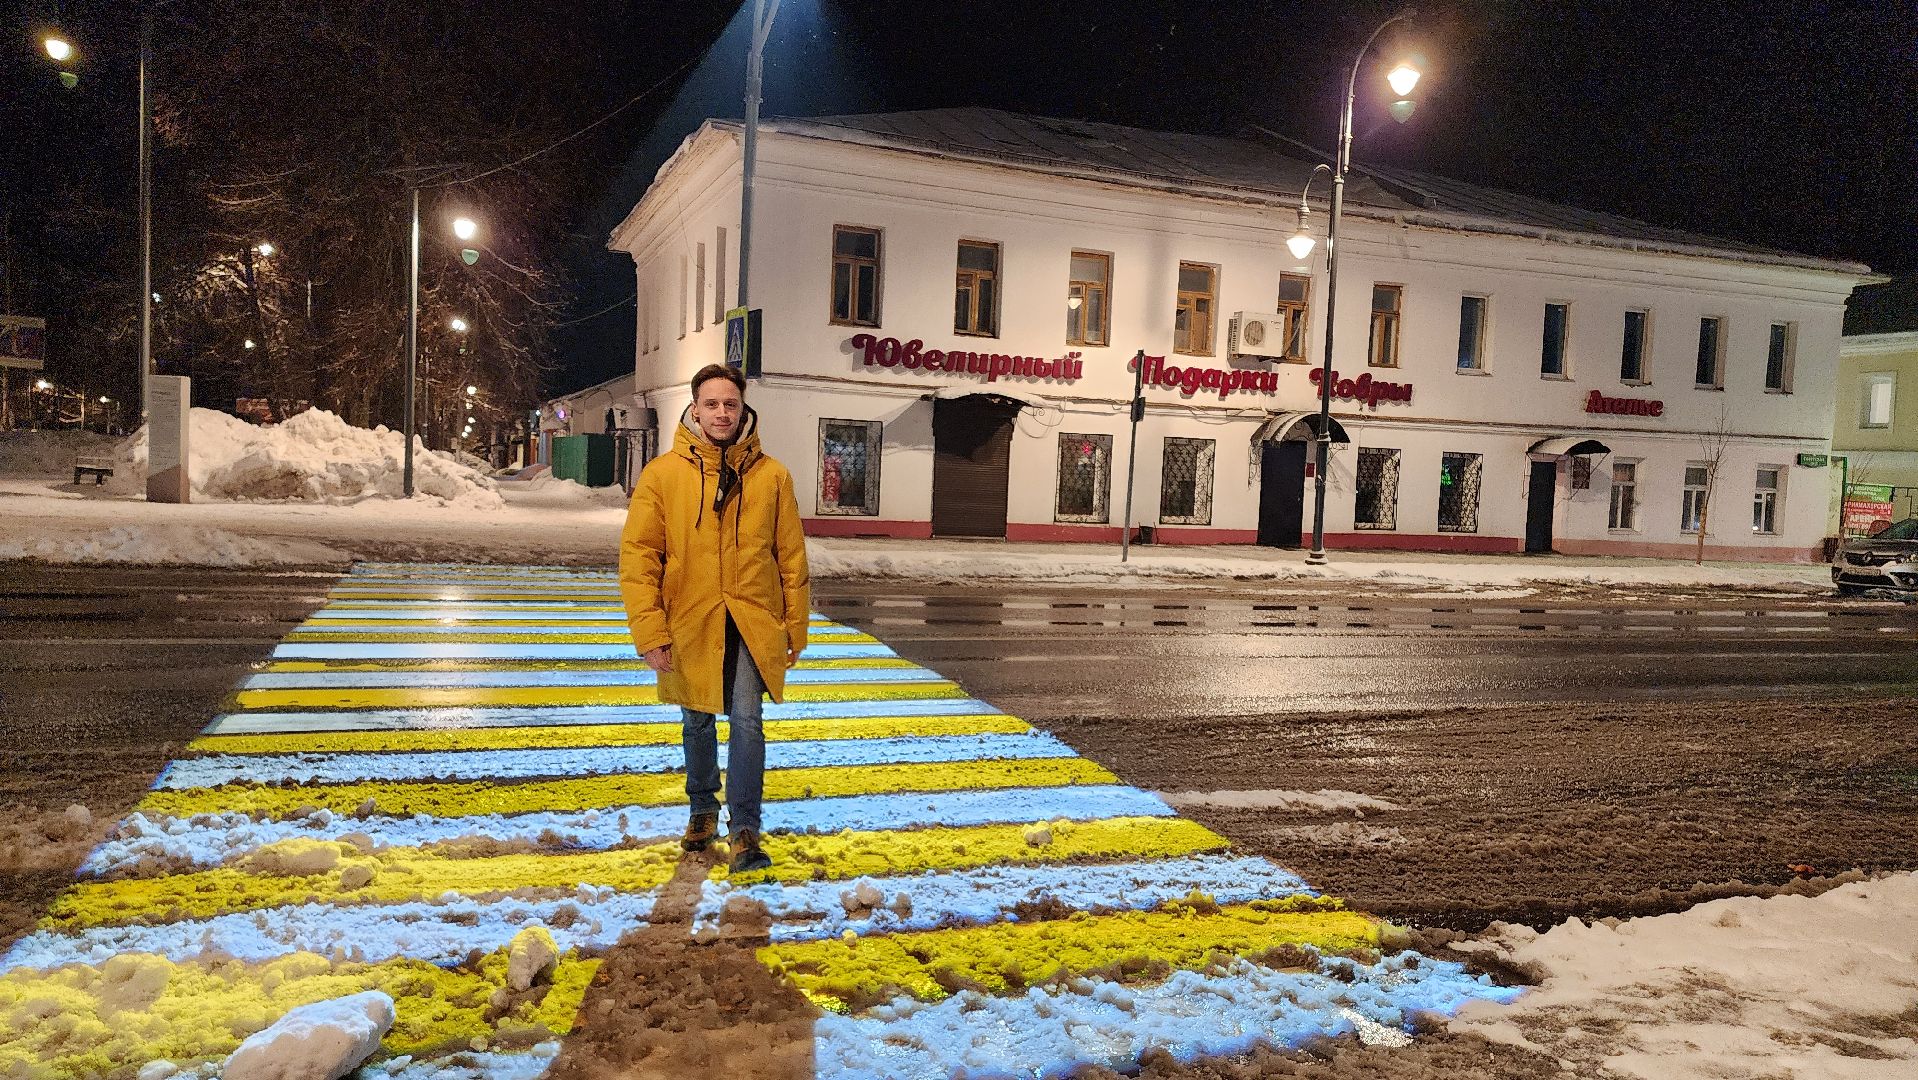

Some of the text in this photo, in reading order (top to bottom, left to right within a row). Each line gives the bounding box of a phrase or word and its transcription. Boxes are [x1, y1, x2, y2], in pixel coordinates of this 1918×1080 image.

[852, 333, 1084, 382] Ювелирный
[1130, 355, 1279, 397] Подарки
[1308, 367, 1413, 408] Ковры
[1585, 389, 1664, 417] Ателье
